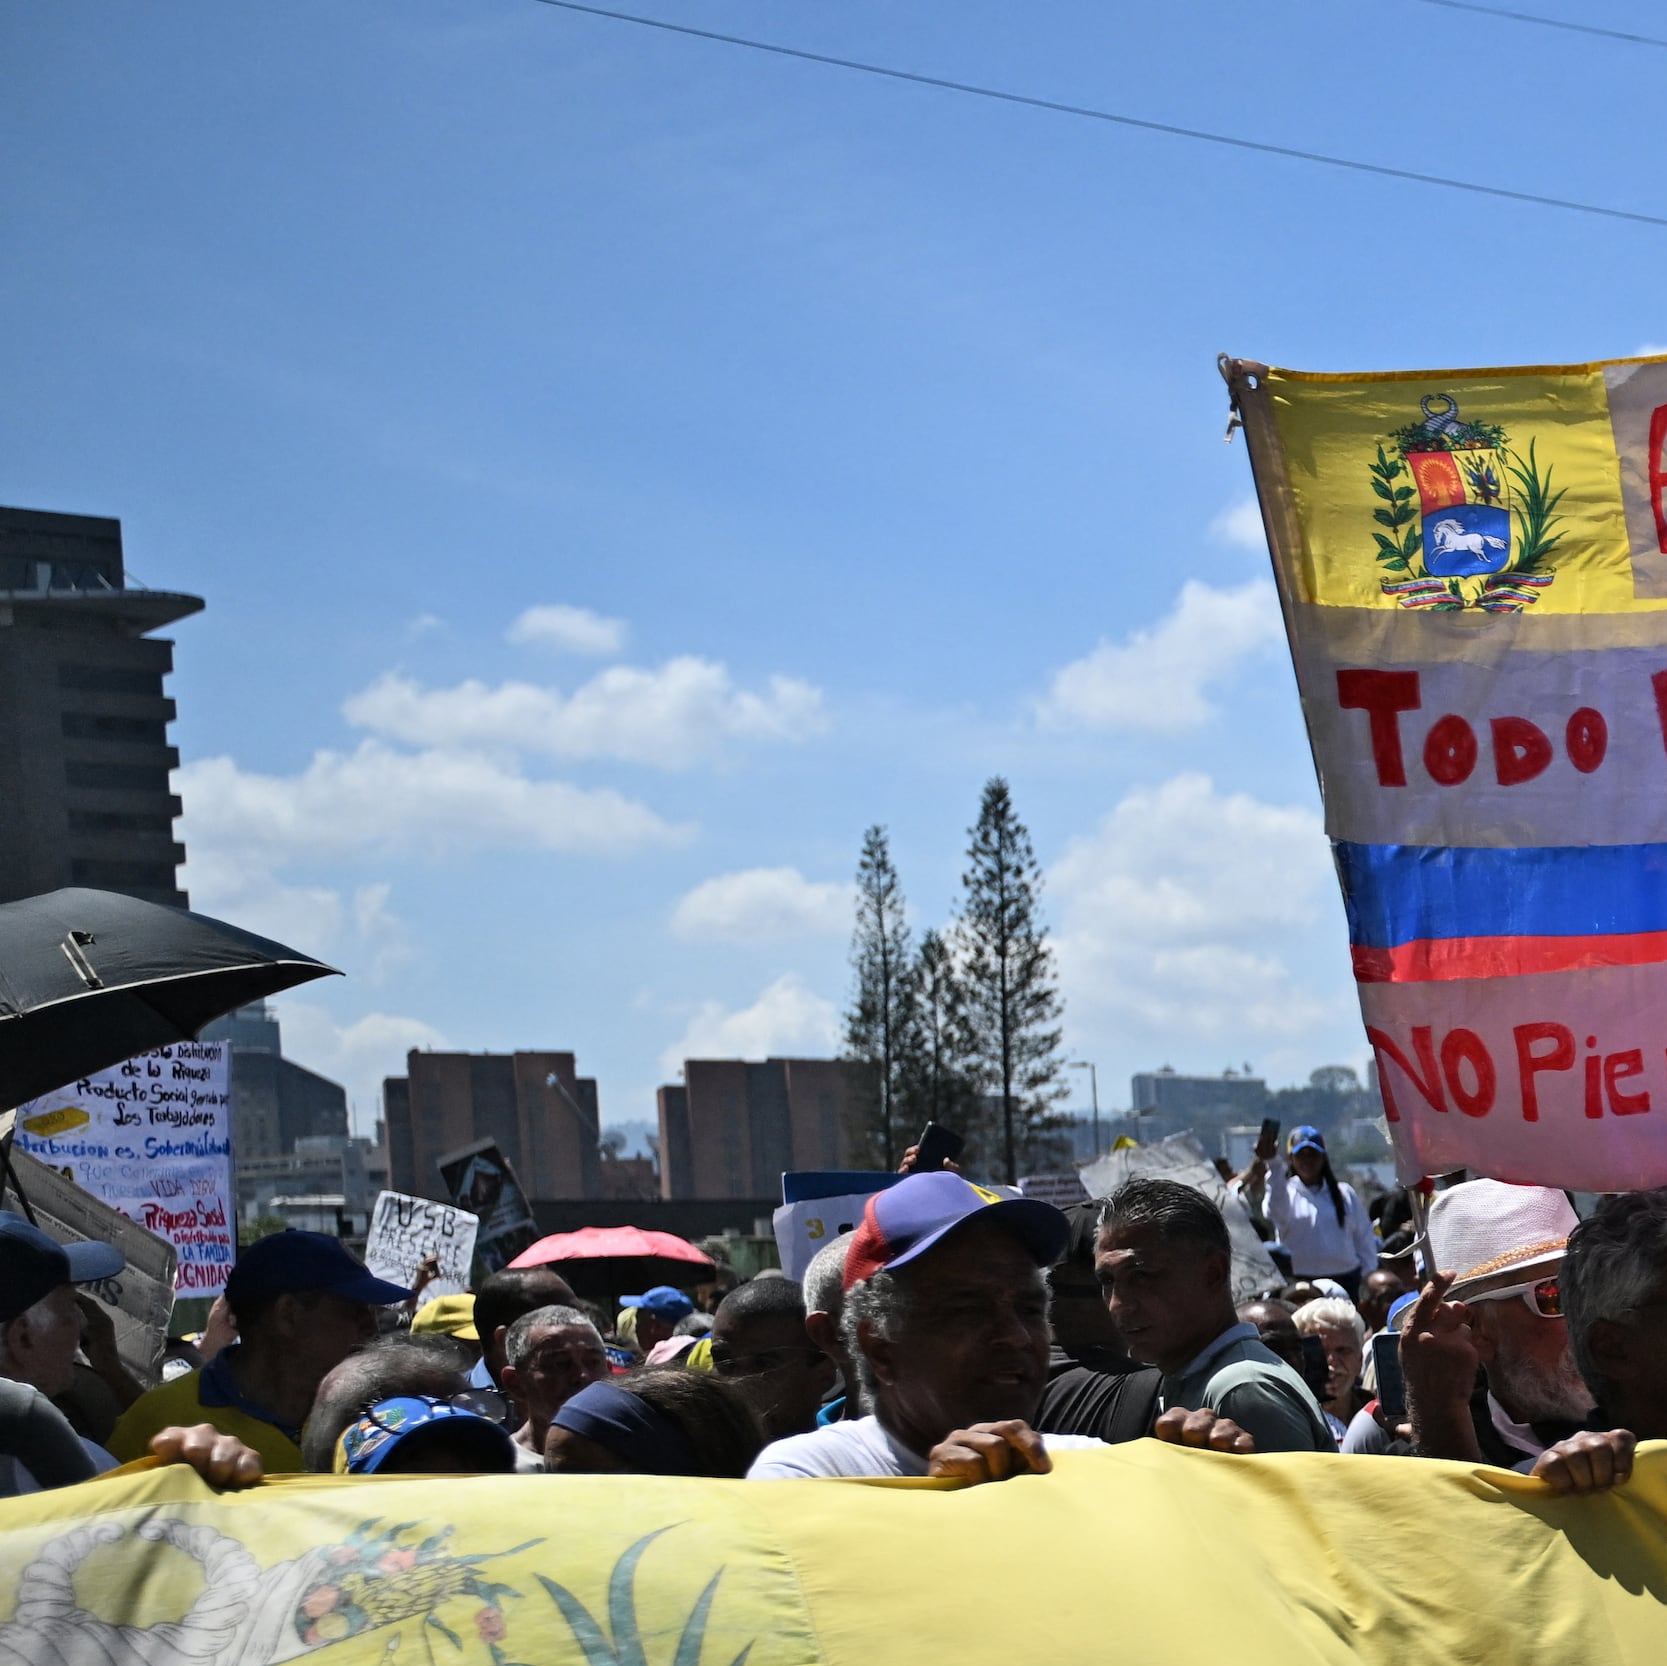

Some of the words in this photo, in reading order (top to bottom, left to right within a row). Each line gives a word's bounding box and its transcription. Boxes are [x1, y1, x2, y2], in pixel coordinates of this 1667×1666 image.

[1369, 1026, 1496, 1122] NO
[76, 1079, 147, 1101] Producto
[151, 1083, 189, 1105] Social
[14, 1133, 108, 1157] tribucion
[141, 1202, 198, 1236] Riqueza
